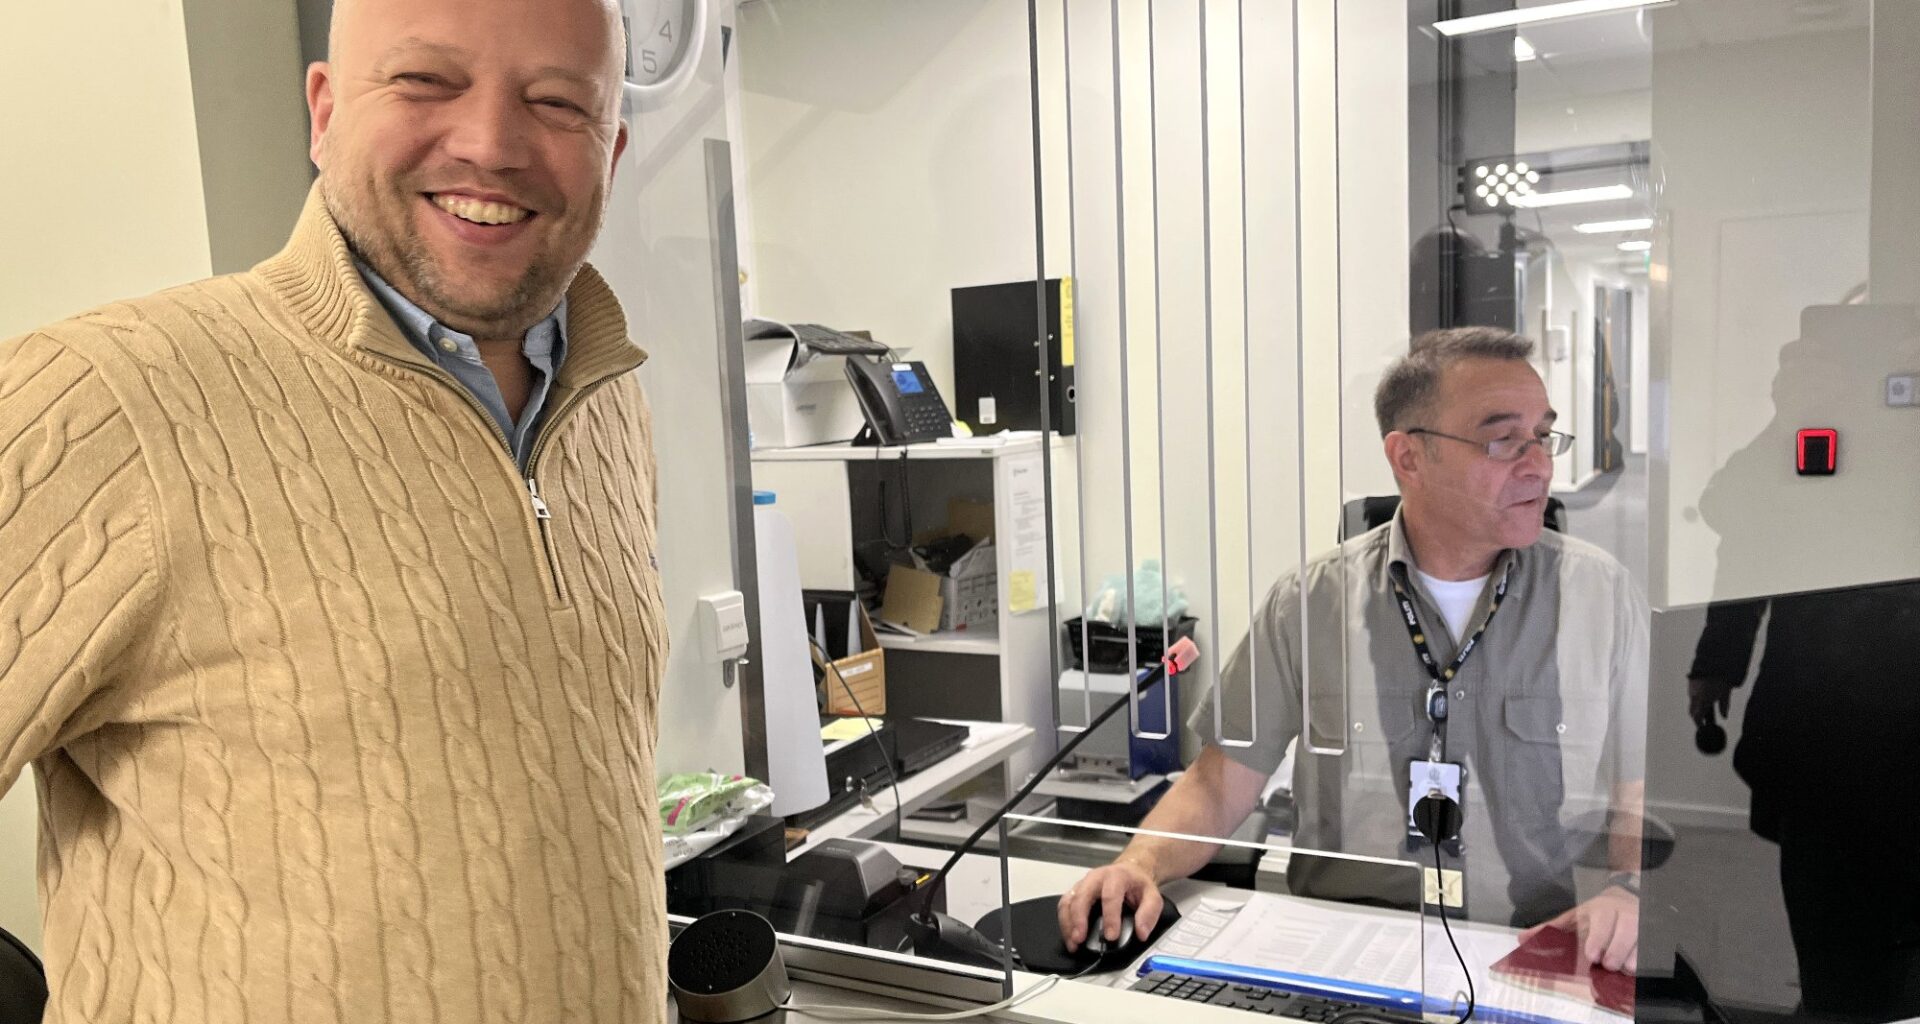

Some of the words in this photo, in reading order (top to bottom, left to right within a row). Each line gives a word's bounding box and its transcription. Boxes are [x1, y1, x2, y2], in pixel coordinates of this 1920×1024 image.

[659, 19, 673, 43] 4
[642, 49, 658, 74] 5
[1402, 600, 1416, 626] POLITI
